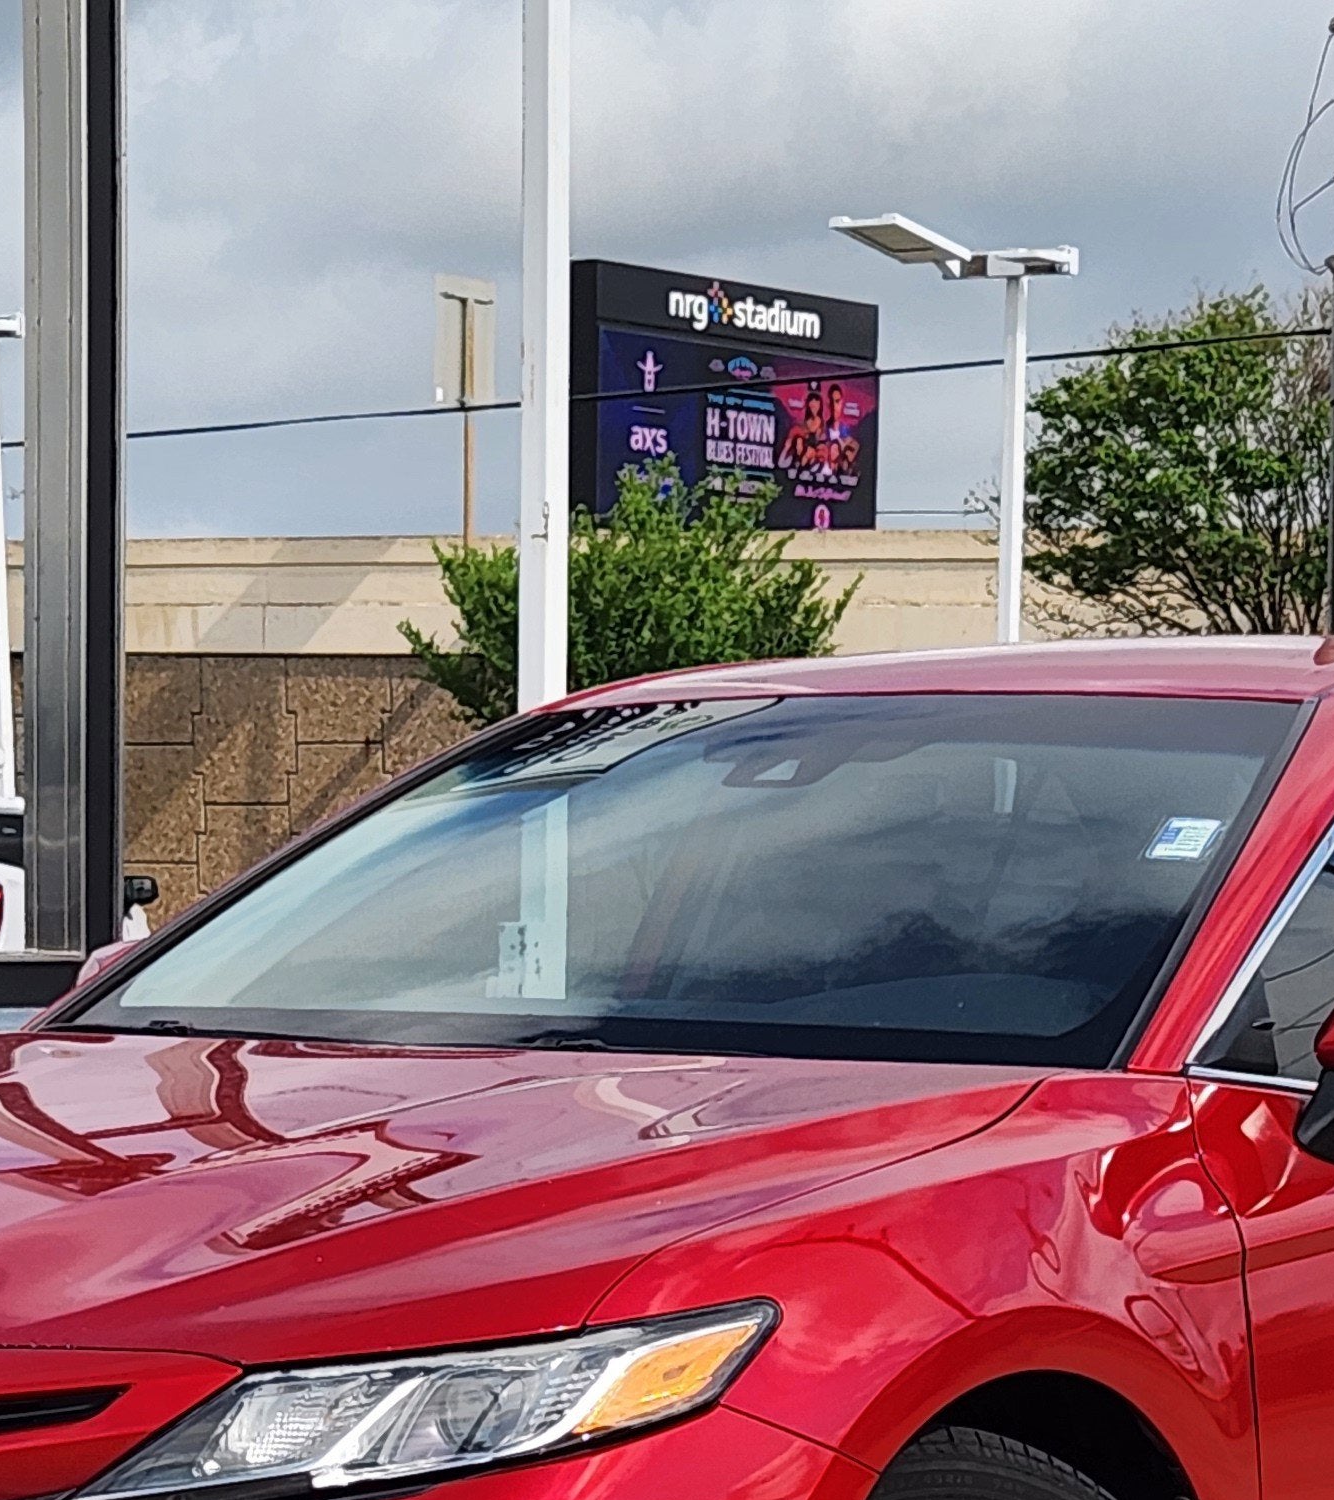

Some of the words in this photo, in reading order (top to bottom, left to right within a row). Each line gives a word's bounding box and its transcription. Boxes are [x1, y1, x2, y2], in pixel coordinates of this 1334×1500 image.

[668, 290, 709, 331] nrg
[732, 297, 821, 339] stadium
[629, 425, 668, 454] axs
[706, 407, 775, 444] H-TOWN
